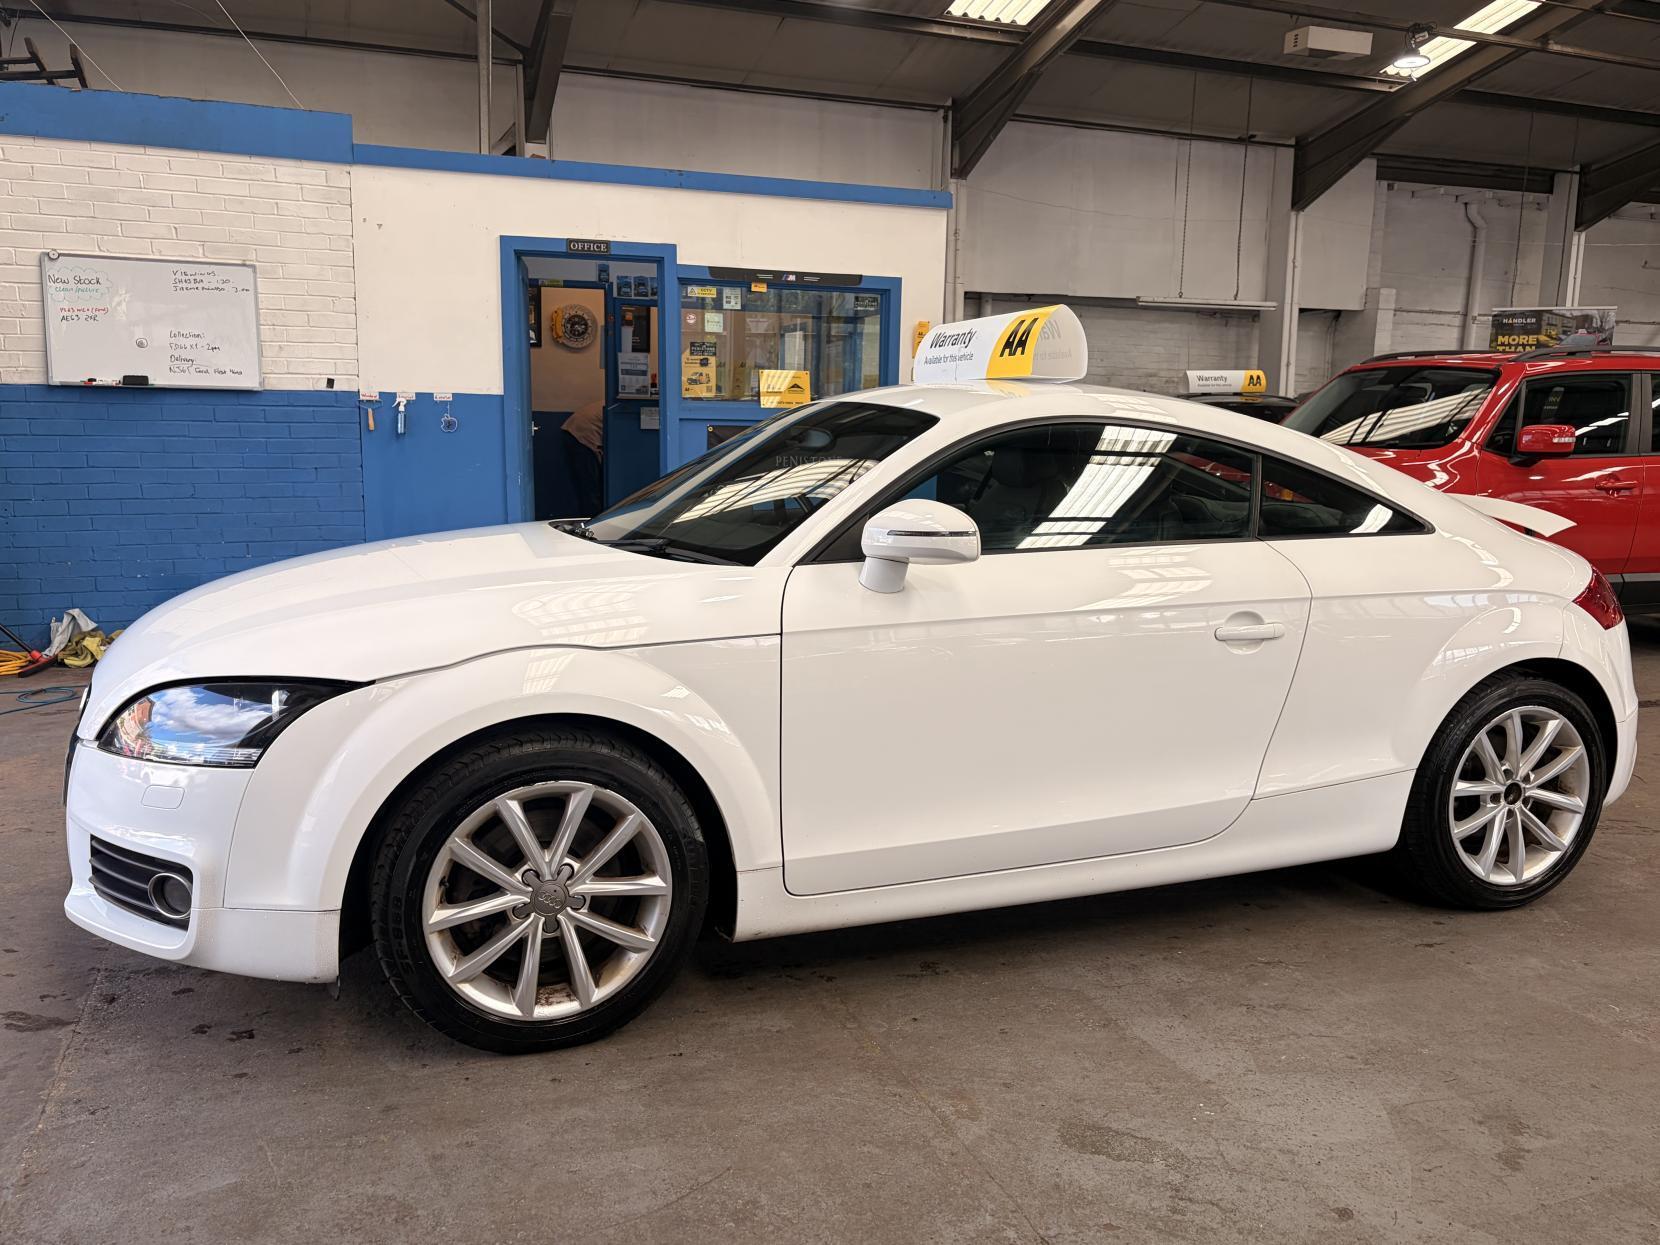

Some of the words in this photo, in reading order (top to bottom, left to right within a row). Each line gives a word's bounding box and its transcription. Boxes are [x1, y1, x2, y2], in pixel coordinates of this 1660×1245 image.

[570, 242, 607, 252] OFFICE
[48, 274, 70, 284] New
[73, 275, 102, 285] Stock
[929, 327, 977, 349] Warranty
[1000, 317, 1039, 357] AA
[1497, 335, 1537, 345] MORE
[924, 354, 942, 366] Available
[949, 353, 957, 363] this
[957, 352, 974, 362] vehicle
[1196, 375, 1228, 383] Warranty
[1248, 375, 1261, 386] AA
[775, 456, 842, 467] PENIST
